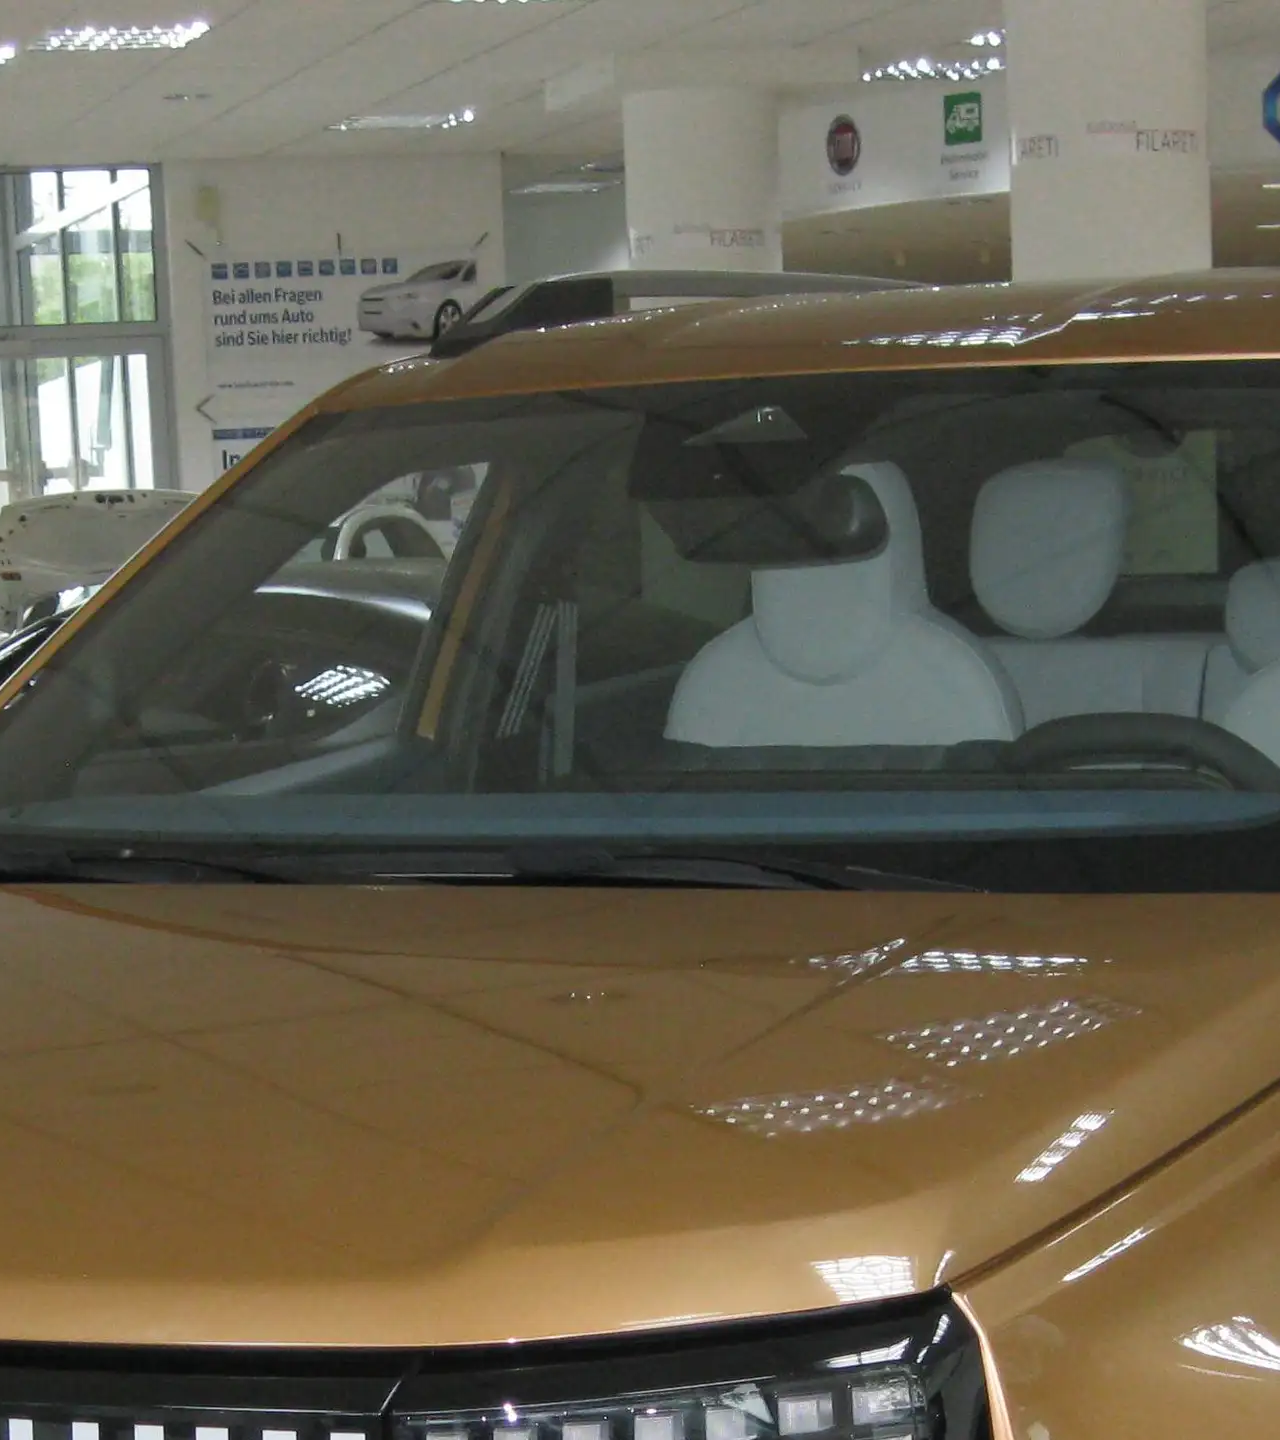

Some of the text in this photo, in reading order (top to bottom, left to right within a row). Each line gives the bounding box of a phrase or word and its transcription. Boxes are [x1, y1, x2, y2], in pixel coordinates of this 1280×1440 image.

[213, 287, 323, 306] Bei allen Fragen
[214, 309, 314, 326] rund ums Auto
[215, 328, 352, 347] sind Sie hier richtig!
